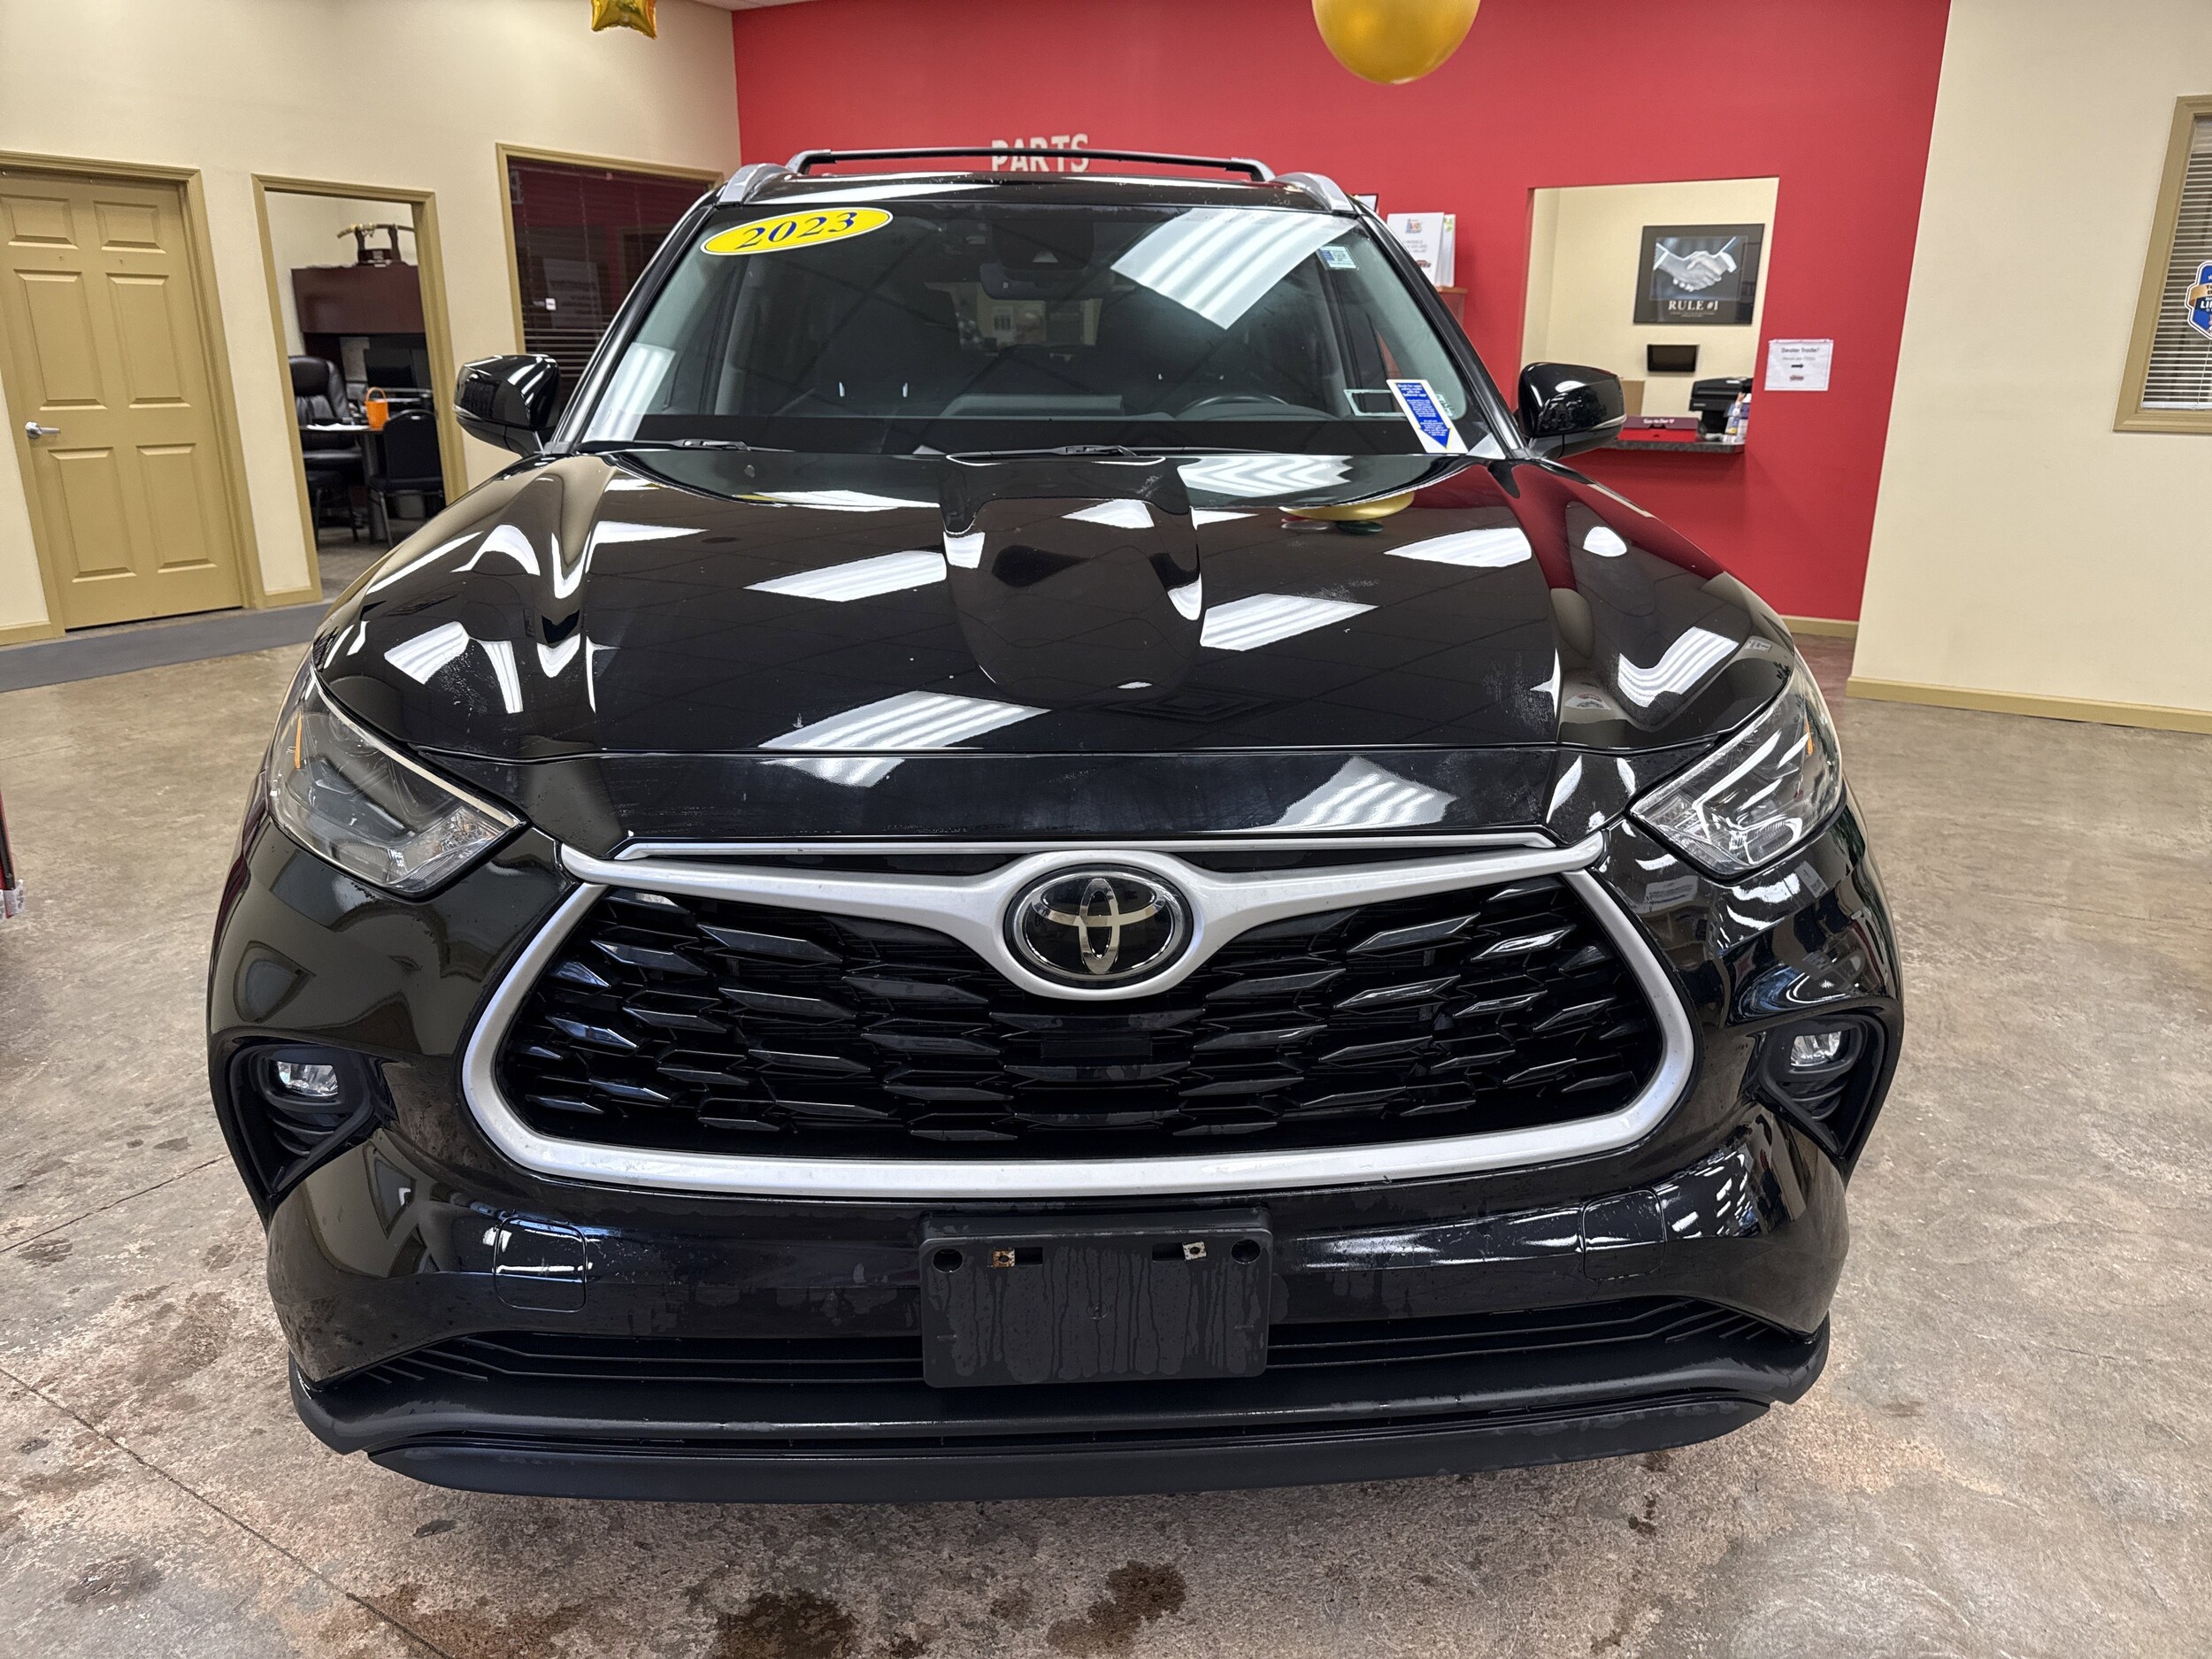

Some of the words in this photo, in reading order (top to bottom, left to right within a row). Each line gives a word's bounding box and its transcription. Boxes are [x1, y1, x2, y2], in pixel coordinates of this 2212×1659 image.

[991, 133, 1089, 173] PARTS
[734, 211, 857, 250] 2023
[1668, 300, 1704, 311] RULE
[1706, 300, 1719, 311] #1
